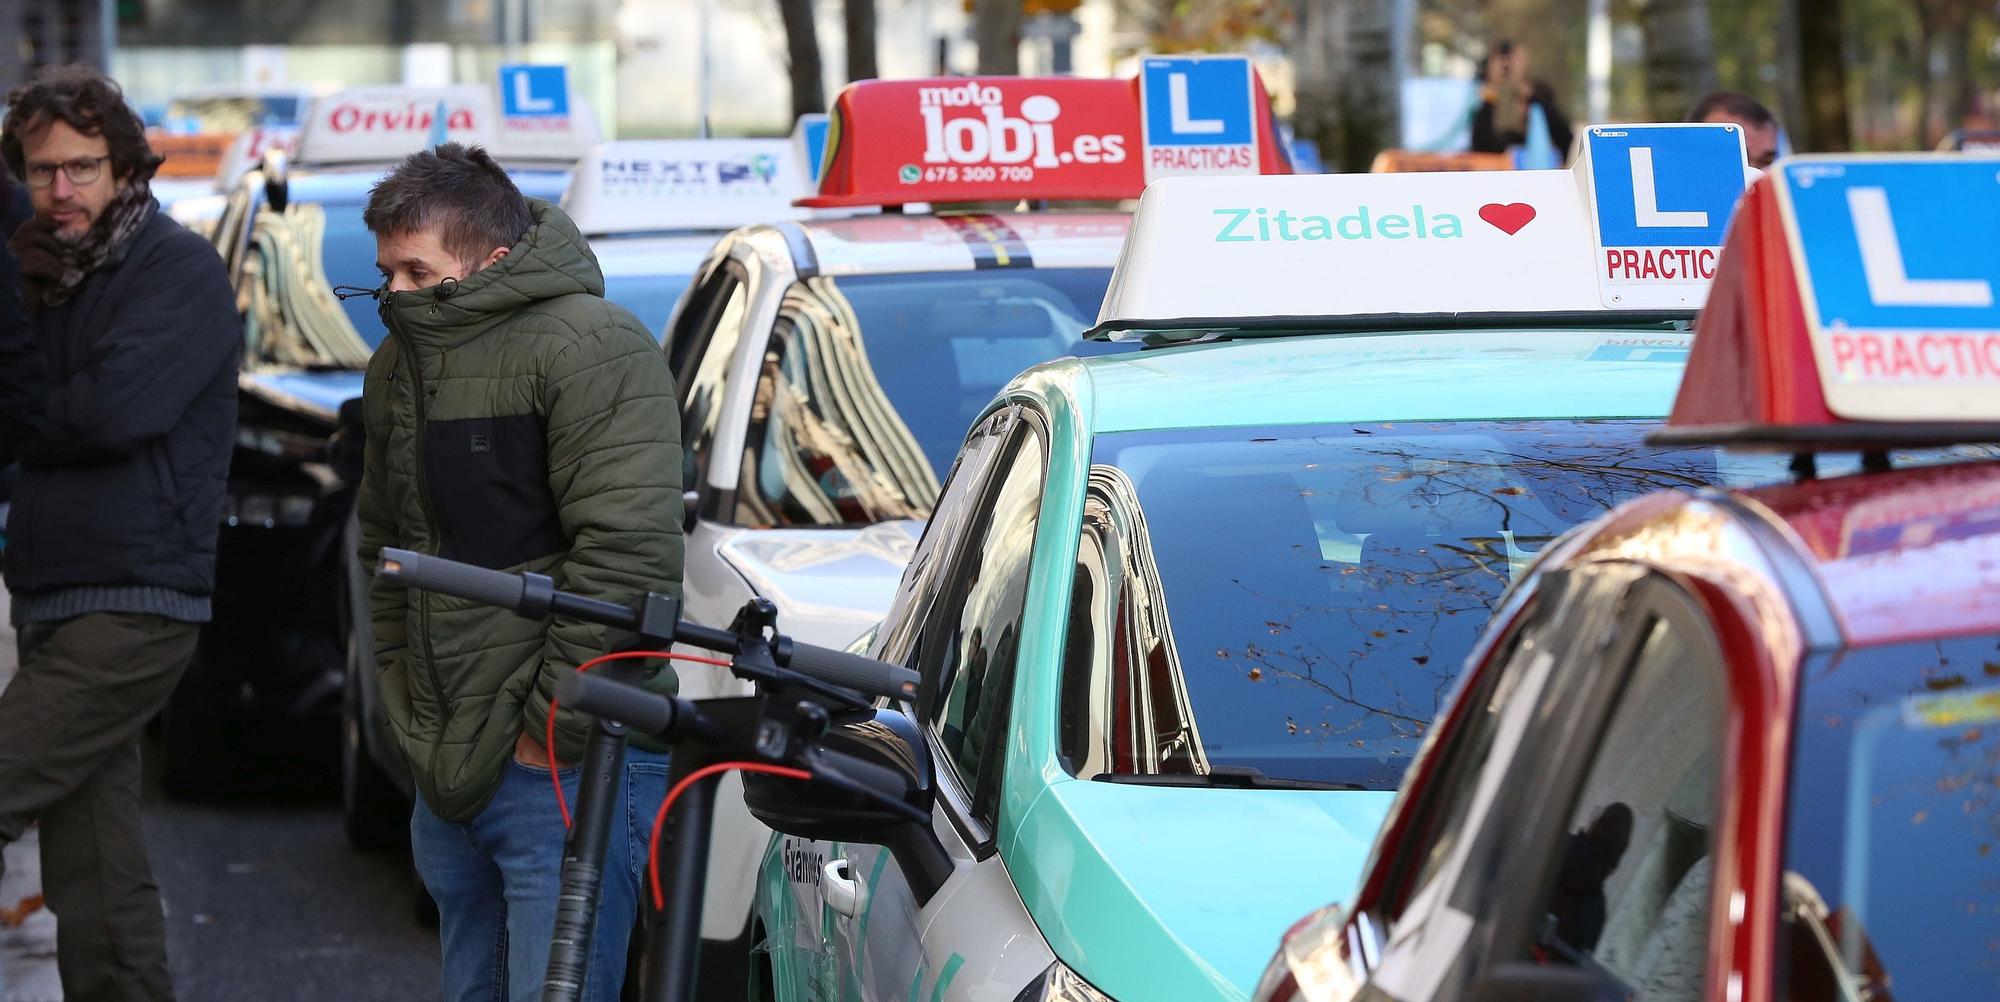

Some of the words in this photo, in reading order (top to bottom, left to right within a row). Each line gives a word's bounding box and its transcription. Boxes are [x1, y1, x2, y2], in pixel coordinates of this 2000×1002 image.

[513, 70, 555, 112] L
[919, 82, 1002, 107] moto
[1168, 72, 1225, 134] L
[920, 95, 1126, 168] lobi.es
[602, 159, 710, 173] NEXT
[924, 166, 959, 182] 675
[961, 166, 997, 182] 300
[999, 166, 1034, 182] 700
[1151, 148, 1252, 169] PRACTICAS
[1629, 146, 1709, 228] L
[1213, 204, 1463, 242] Zitadela
[1606, 249, 1717, 279] PRACTIC
[1845, 186, 1995, 308] L
